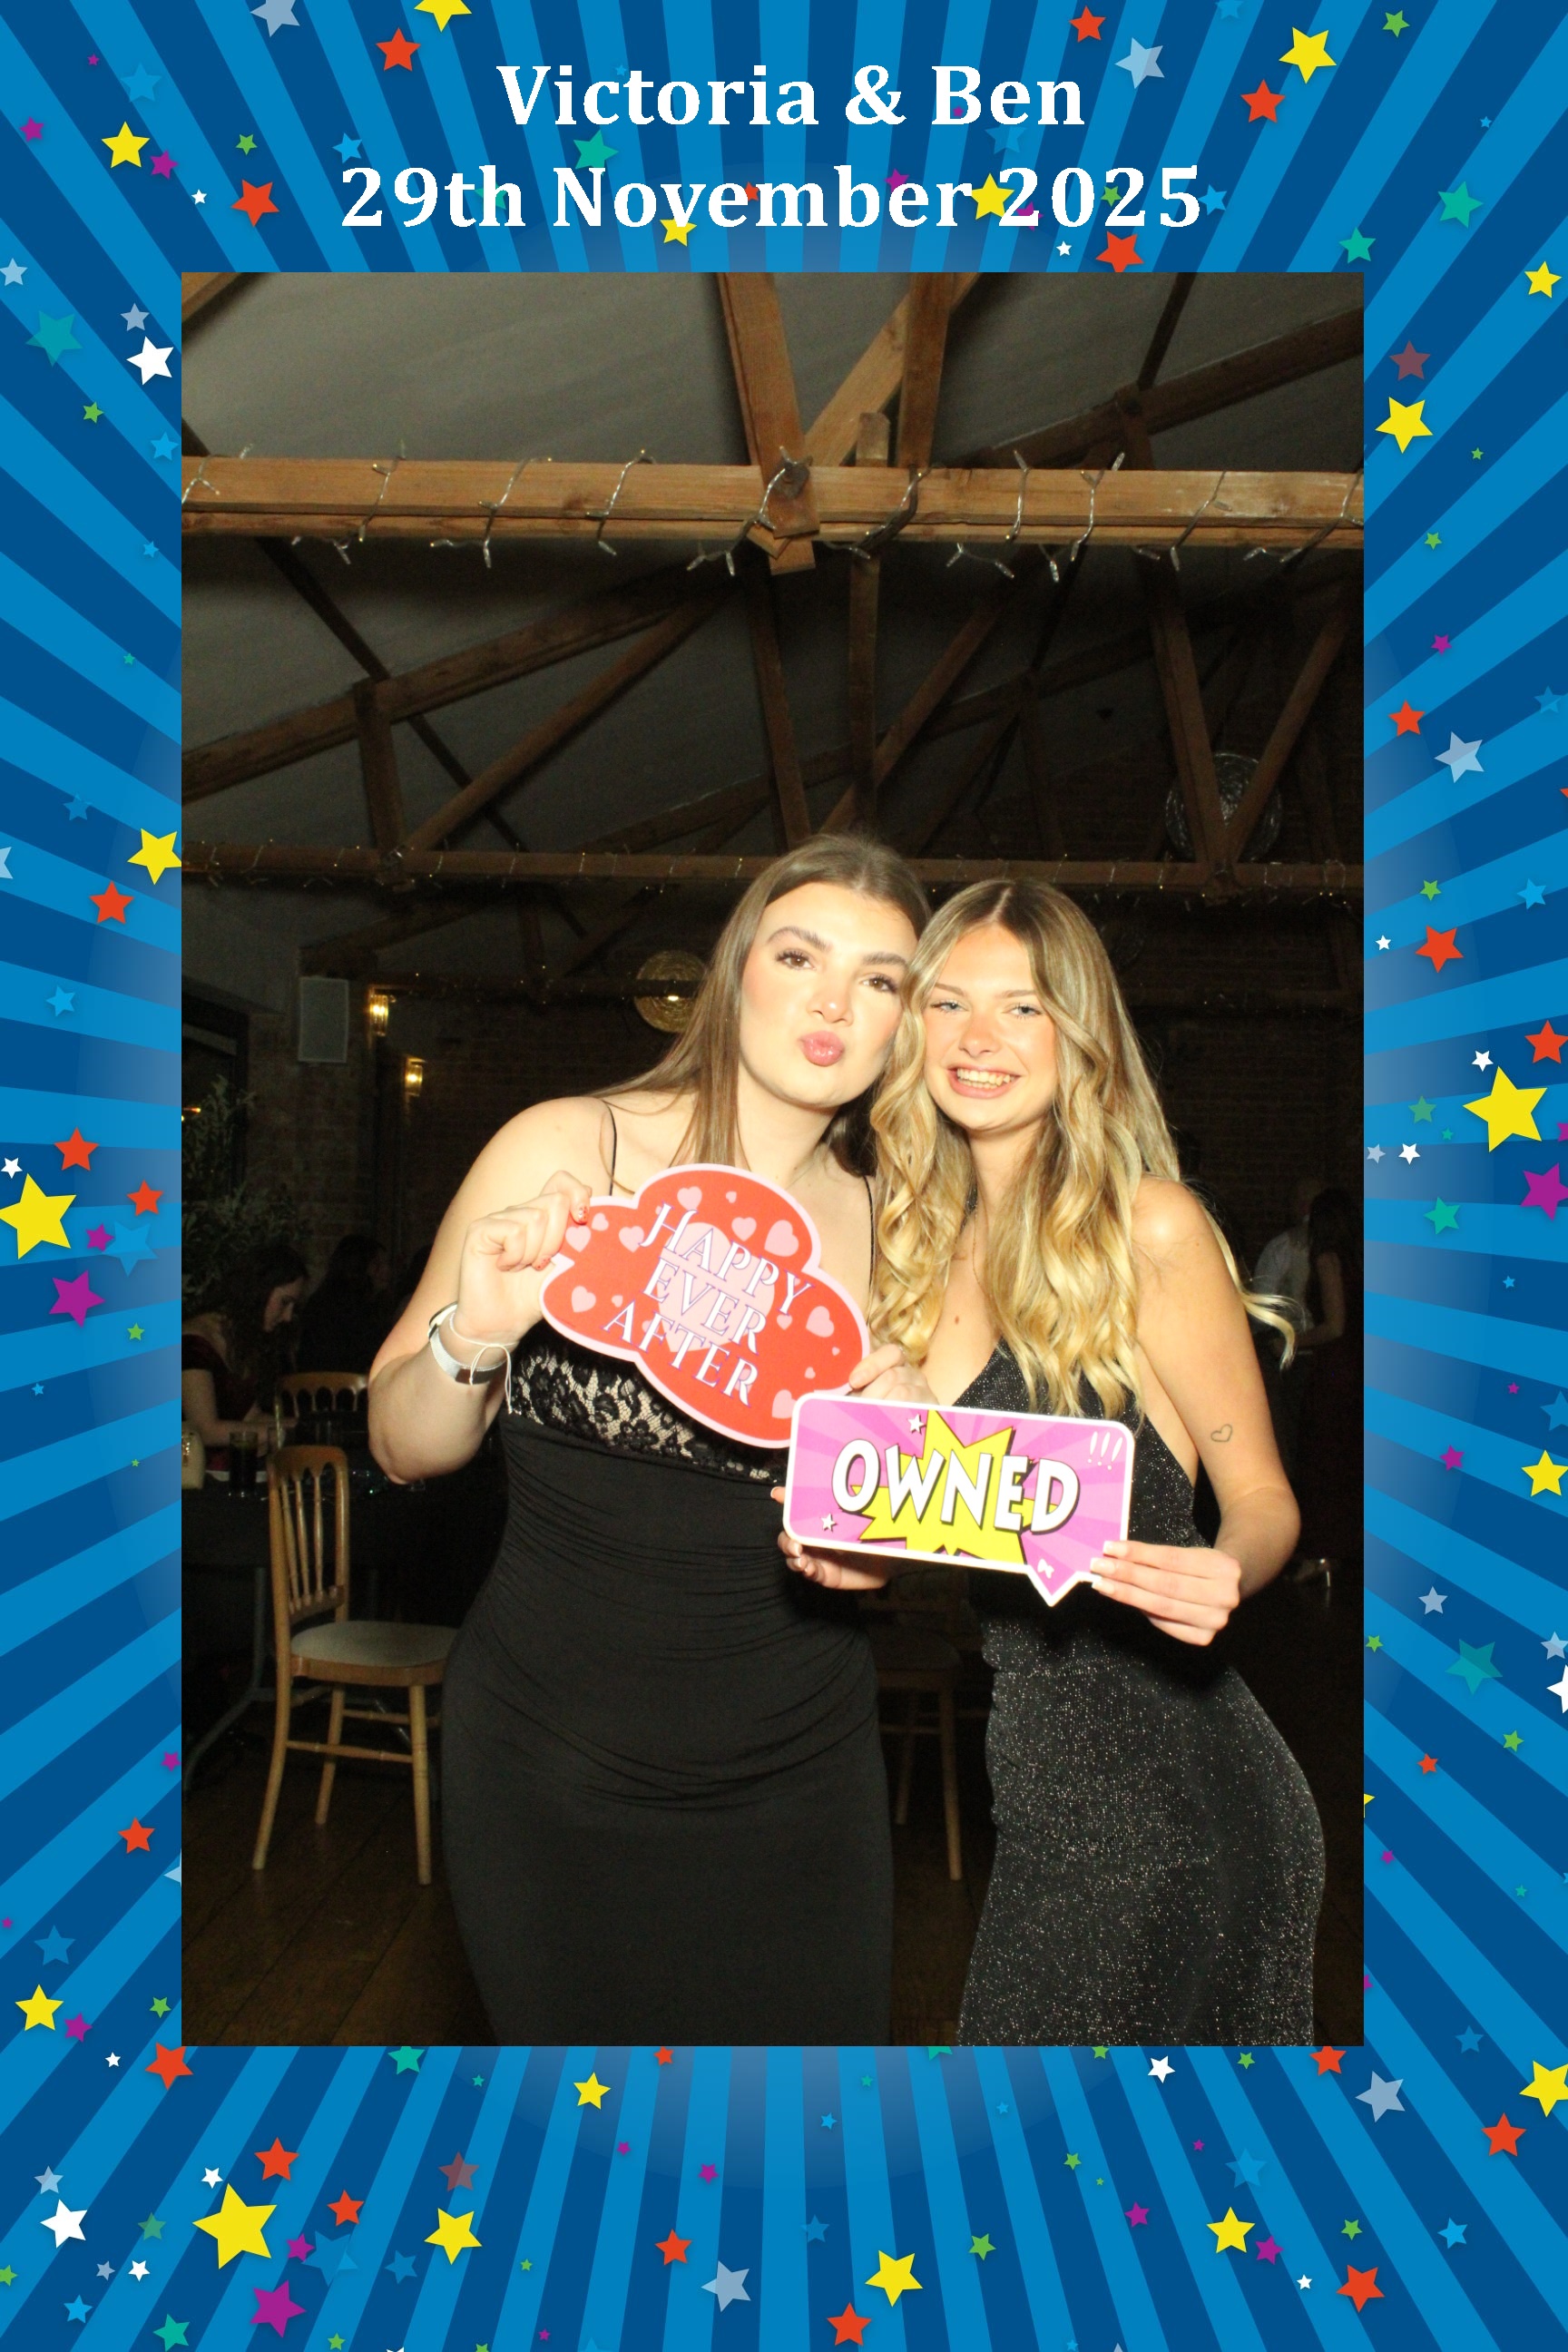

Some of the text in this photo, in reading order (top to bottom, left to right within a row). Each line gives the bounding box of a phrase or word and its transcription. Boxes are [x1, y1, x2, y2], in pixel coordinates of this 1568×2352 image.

[639, 1201, 813, 1315] HAPPY
[643, 1258, 767, 1356] EVER
[603, 1300, 759, 1406] AFTER
[831, 1438, 1081, 1535] OWNED
